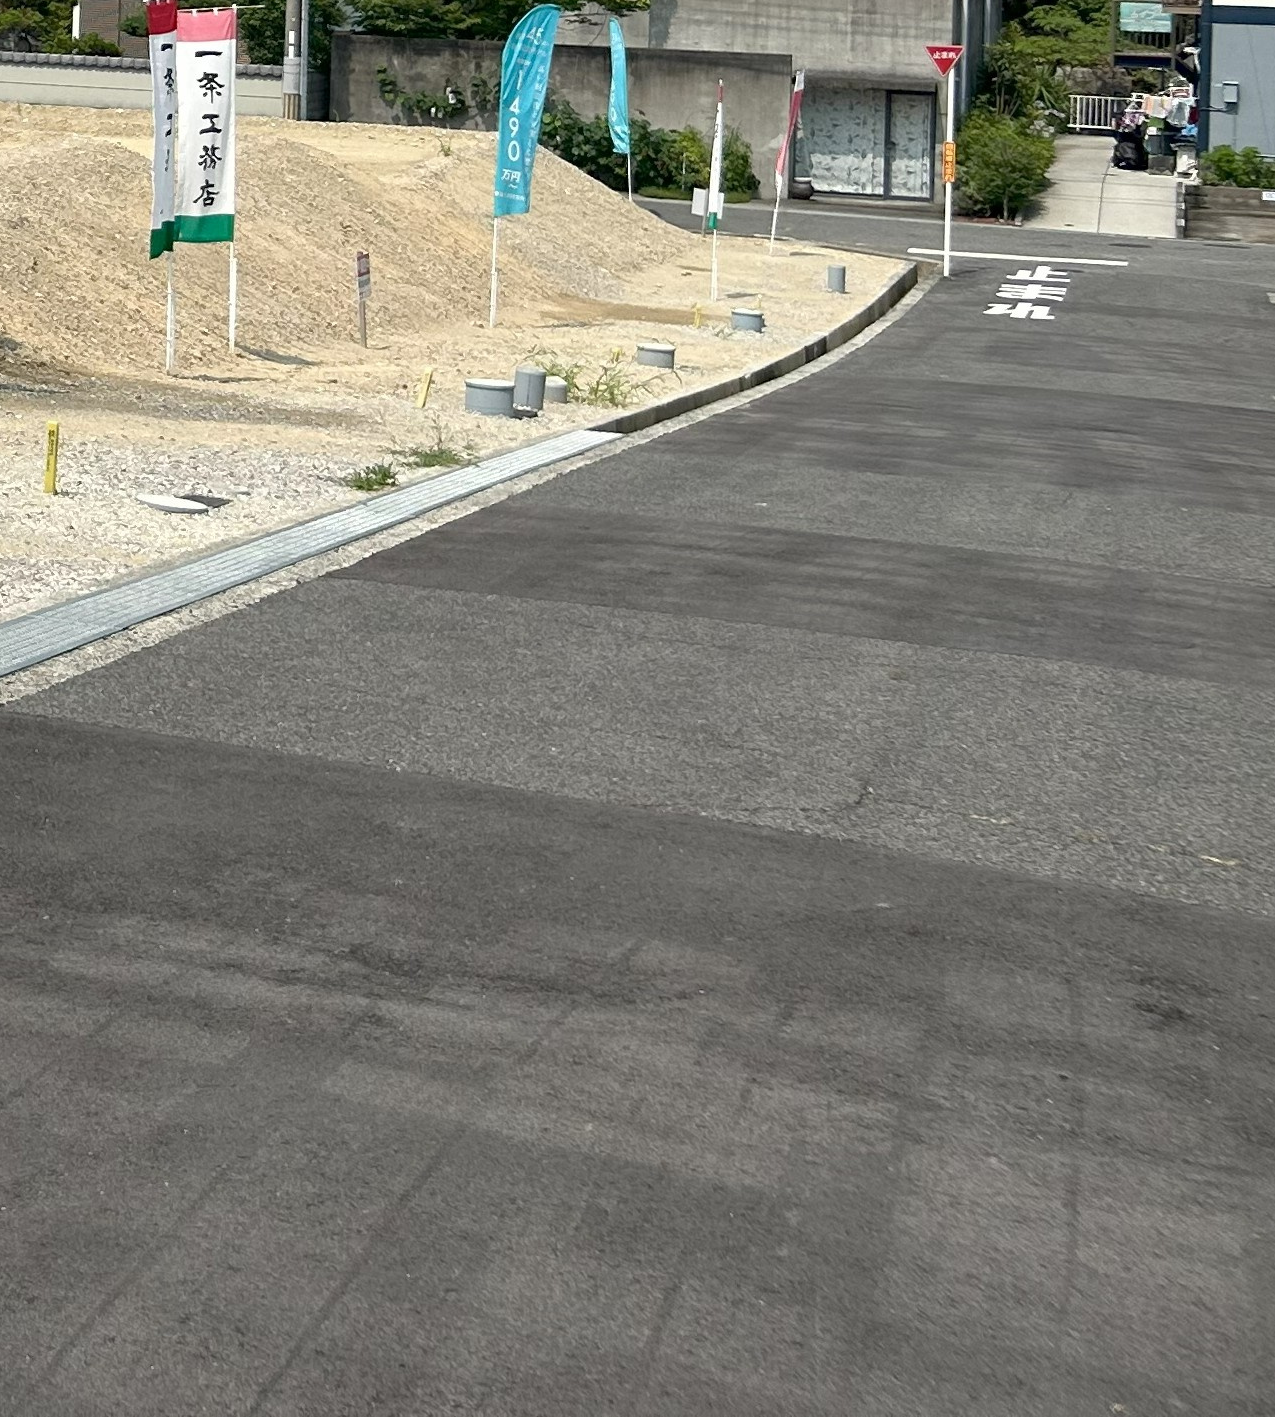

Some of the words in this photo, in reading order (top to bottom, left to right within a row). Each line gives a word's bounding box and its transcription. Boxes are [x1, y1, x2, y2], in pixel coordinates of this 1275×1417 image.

[932, 50, 958, 59] 止まれ
[193, 49, 225, 208] 一条工務店
[982, 265, 1071, 320] 止まれ
